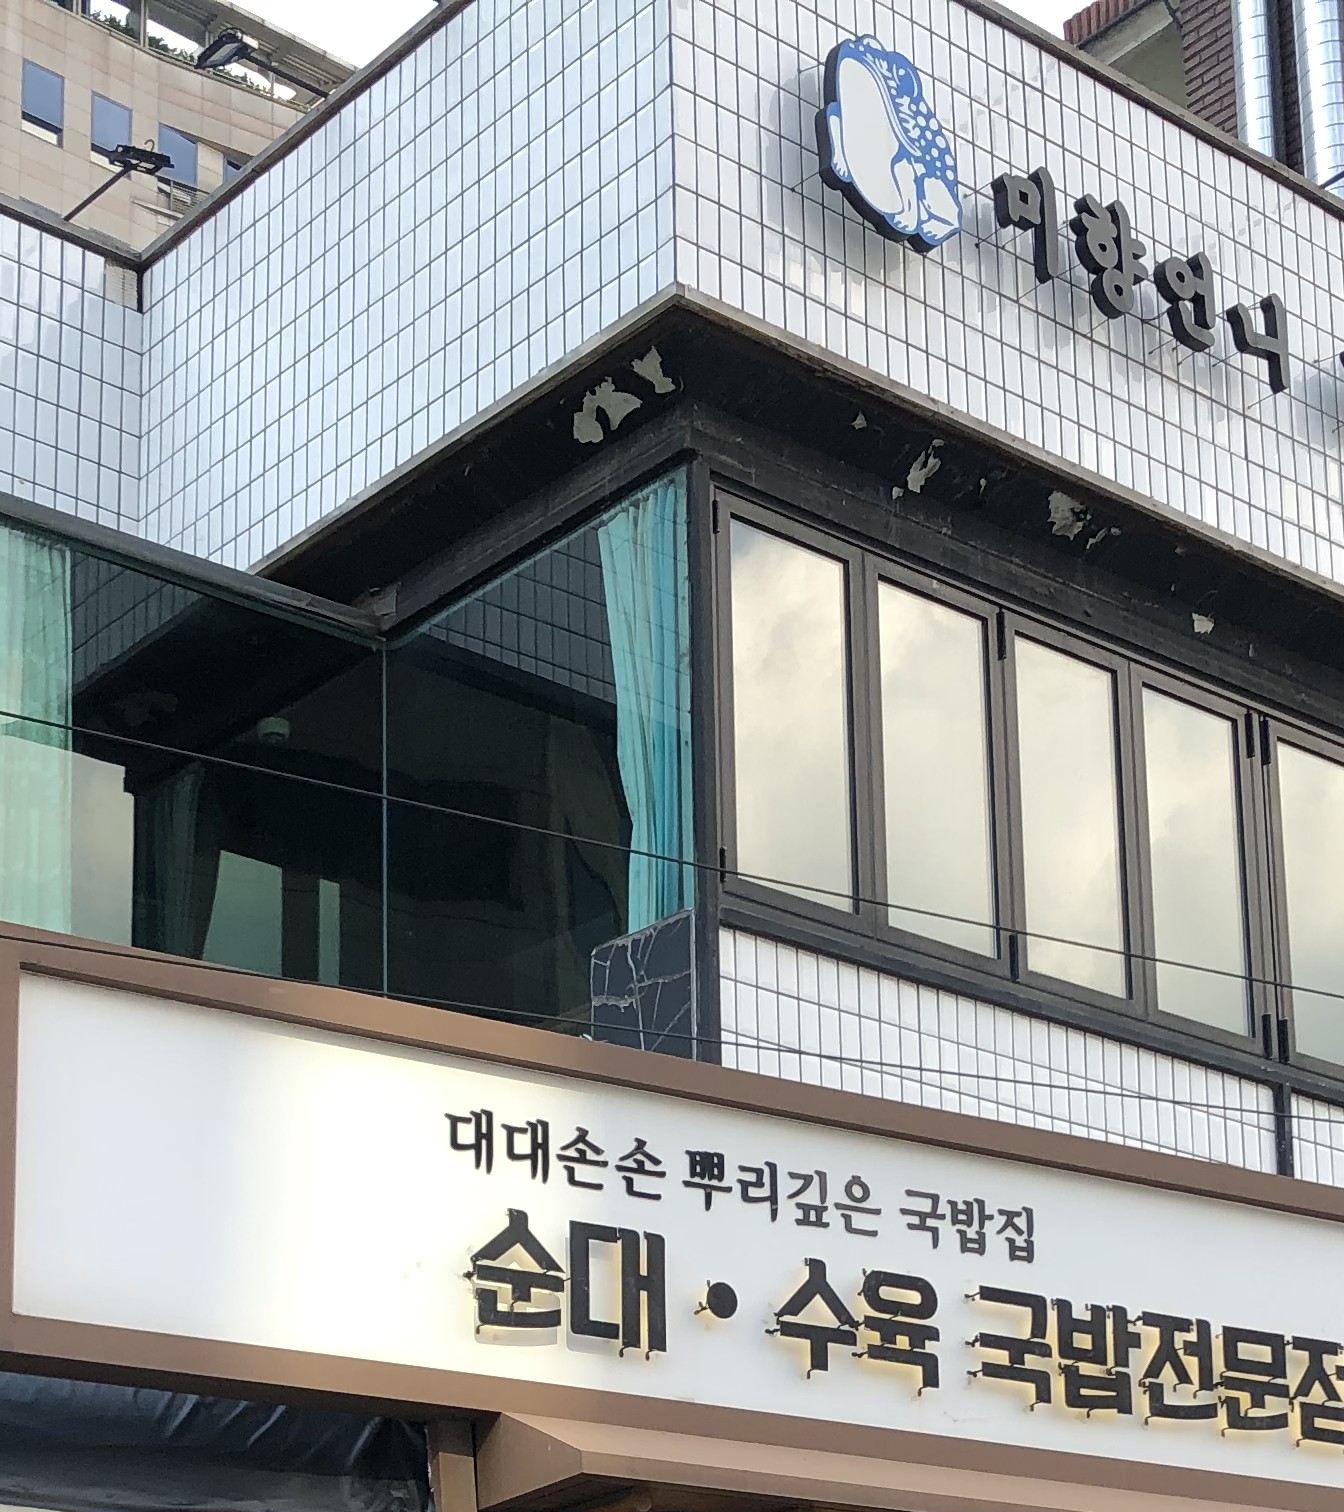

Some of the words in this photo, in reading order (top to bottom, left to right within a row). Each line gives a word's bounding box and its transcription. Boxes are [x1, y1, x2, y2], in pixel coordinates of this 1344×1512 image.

[992, 167, 1288, 394] 미향언니
[445, 1109, 667, 1202] 대대손손
[681, 1148, 884, 1237] 뿌리깊은
[898, 1191, 1037, 1265] 국밥집
[471, 1208, 668, 1354] 순대
[768, 1257, 941, 1394] 수육
